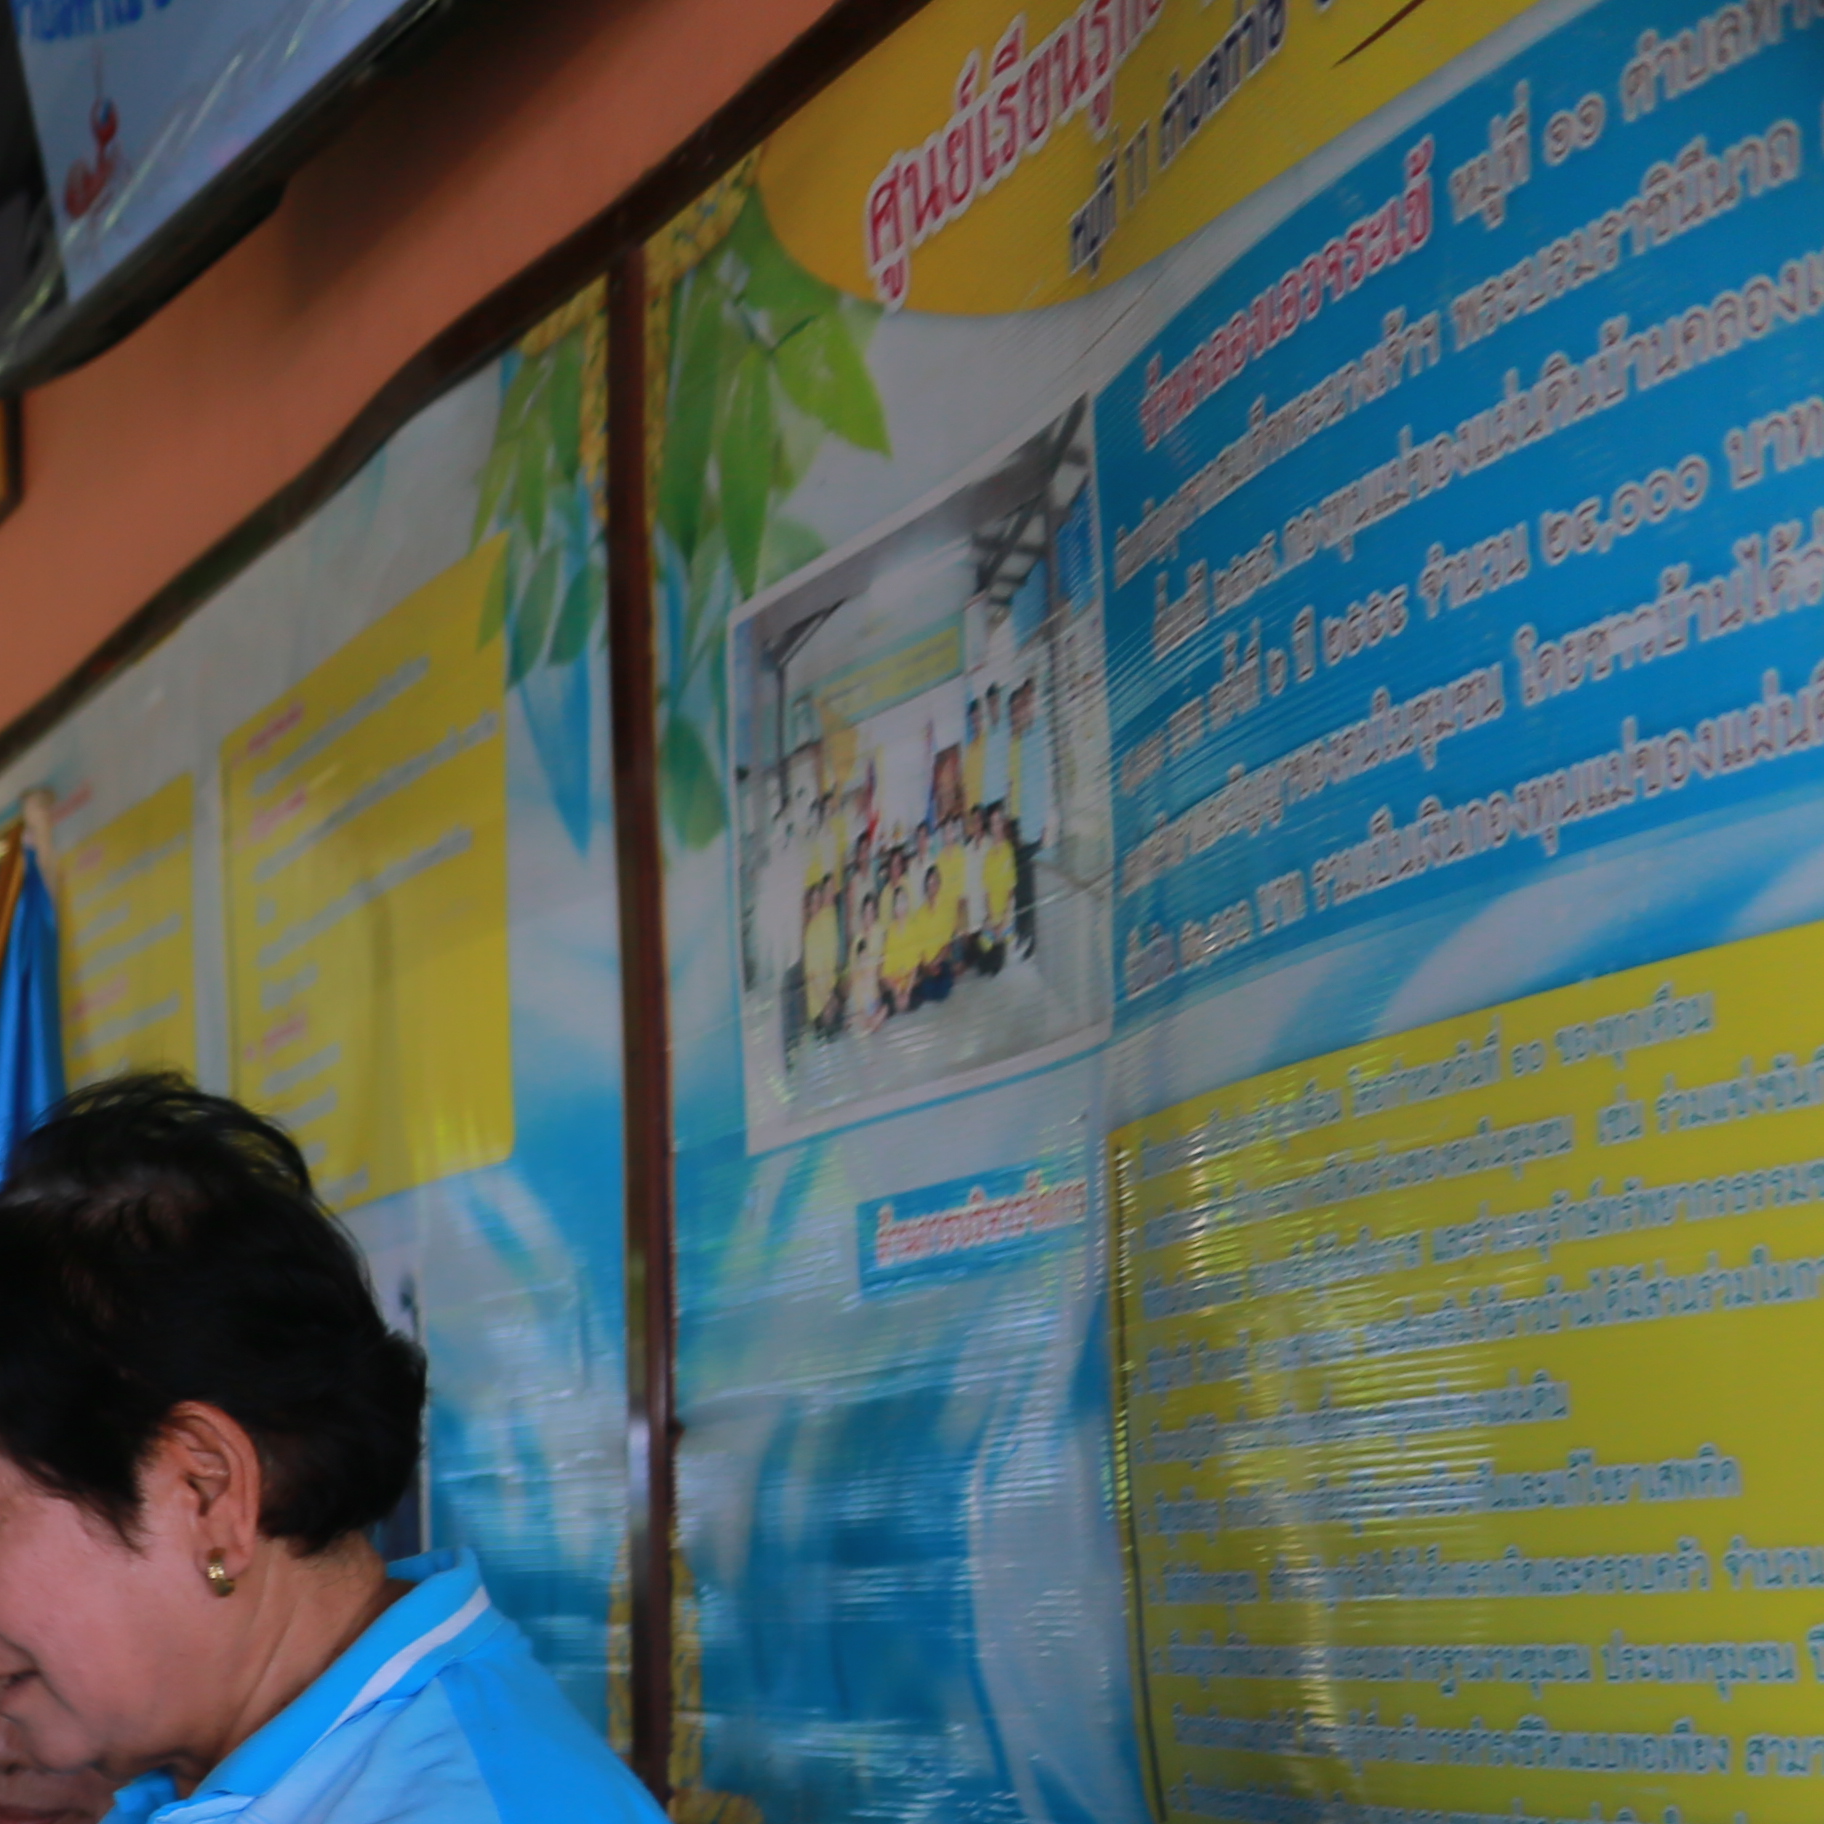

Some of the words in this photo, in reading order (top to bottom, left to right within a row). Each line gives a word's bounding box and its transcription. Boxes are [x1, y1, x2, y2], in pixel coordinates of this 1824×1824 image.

[1448, 77, 1532, 231] หมู่ที่
[1541, 90, 1607, 167] ๑๑
[1449, 117, 1800, 354] พระบรมราชินีนาถ
[1413, 520, 1524, 618] จำนวน
